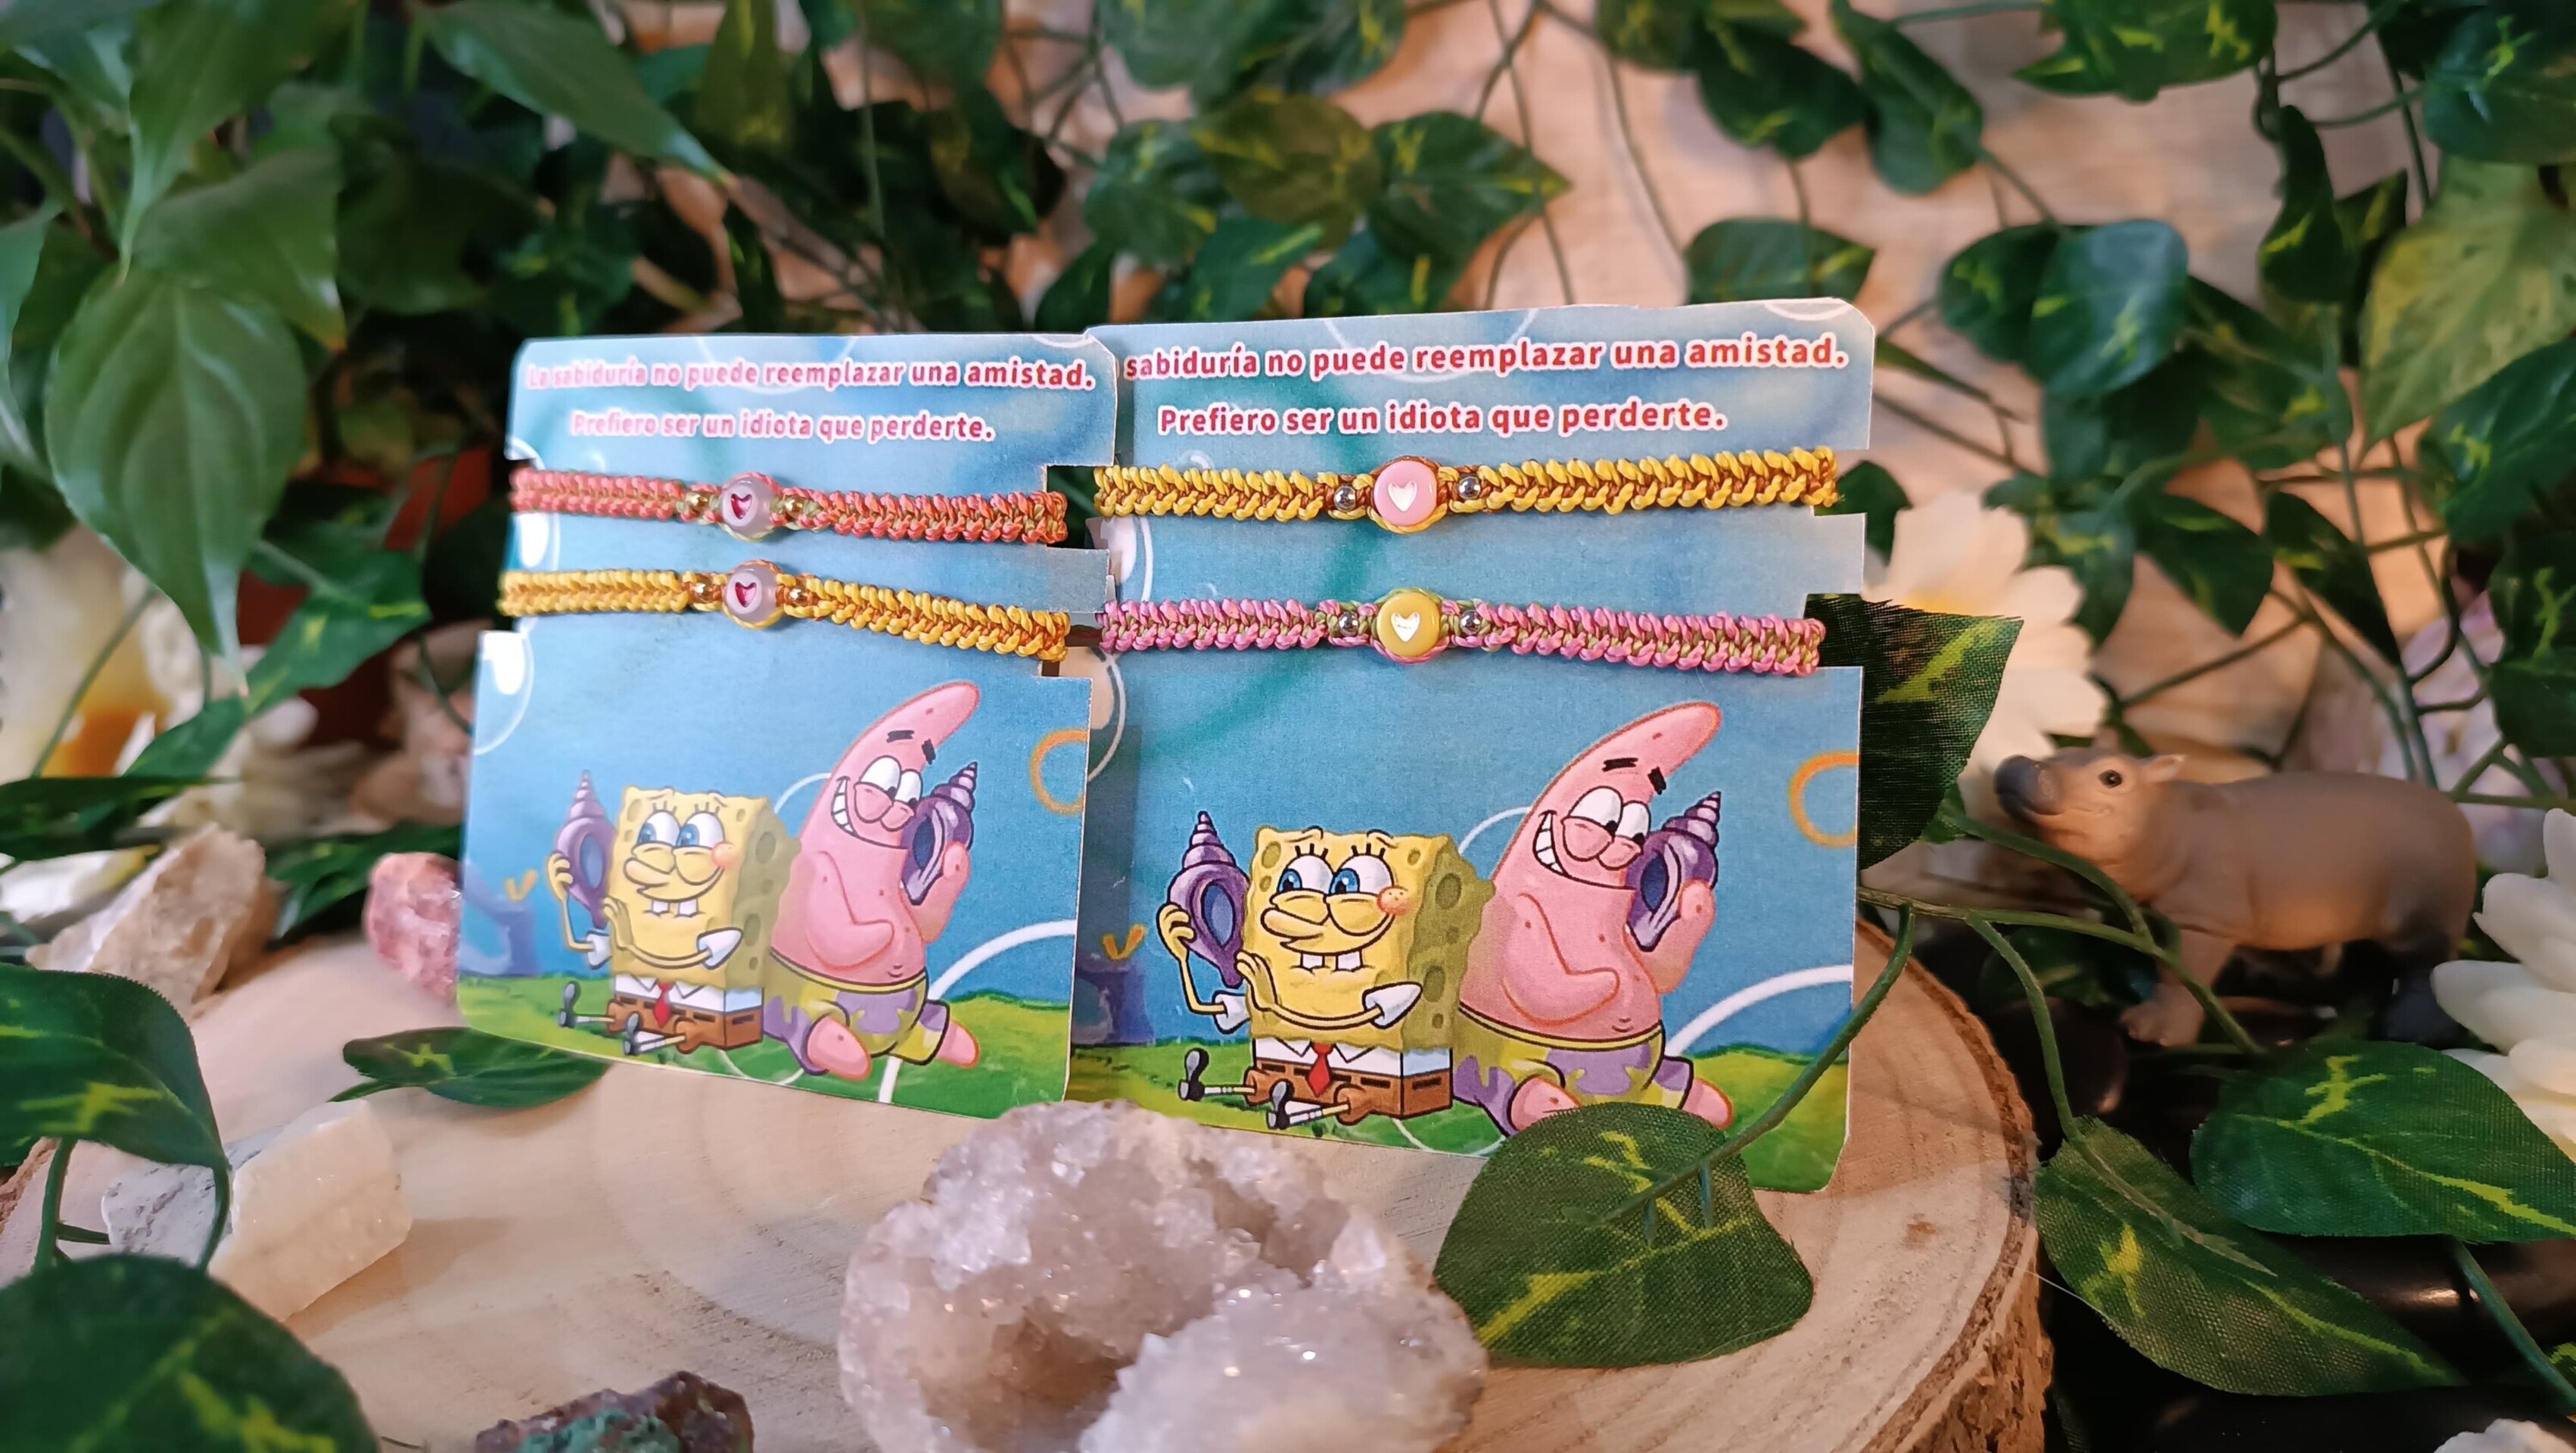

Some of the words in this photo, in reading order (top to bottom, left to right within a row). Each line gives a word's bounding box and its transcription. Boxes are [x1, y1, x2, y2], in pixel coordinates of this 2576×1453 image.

[1125, 345, 1257, 377] sabiduría
[1268, 353, 1303, 373] no
[1314, 344, 1405, 376] puede
[1415, 341, 1603, 373] reemplazar
[1615, 342, 1676, 364] una
[1689, 336, 1845, 365] amistad.
[552, 358, 646, 386] sabiduría
[653, 365, 680, 386] no
[687, 361, 758, 389] puede
[766, 360, 904, 388] reemplazar
[912, 363, 958, 383] una
[967, 359, 1093, 387] amistad.
[573, 409, 656, 435] Prefiero
[664, 415, 700, 435] ser
[705, 415, 733, 435] un
[742, 412, 811, 437] idiota
[820, 417, 862, 440] que
[871, 414, 993, 441] perderte.
[1161, 407, 1276, 432] Prefiero
[1286, 411, 1331, 431] ser
[1342, 410, 1378, 430] un
[1389, 403, 1480, 429] idiota
[1492, 408, 1550, 434] que
[1562, 401, 1724, 434] perderte.
